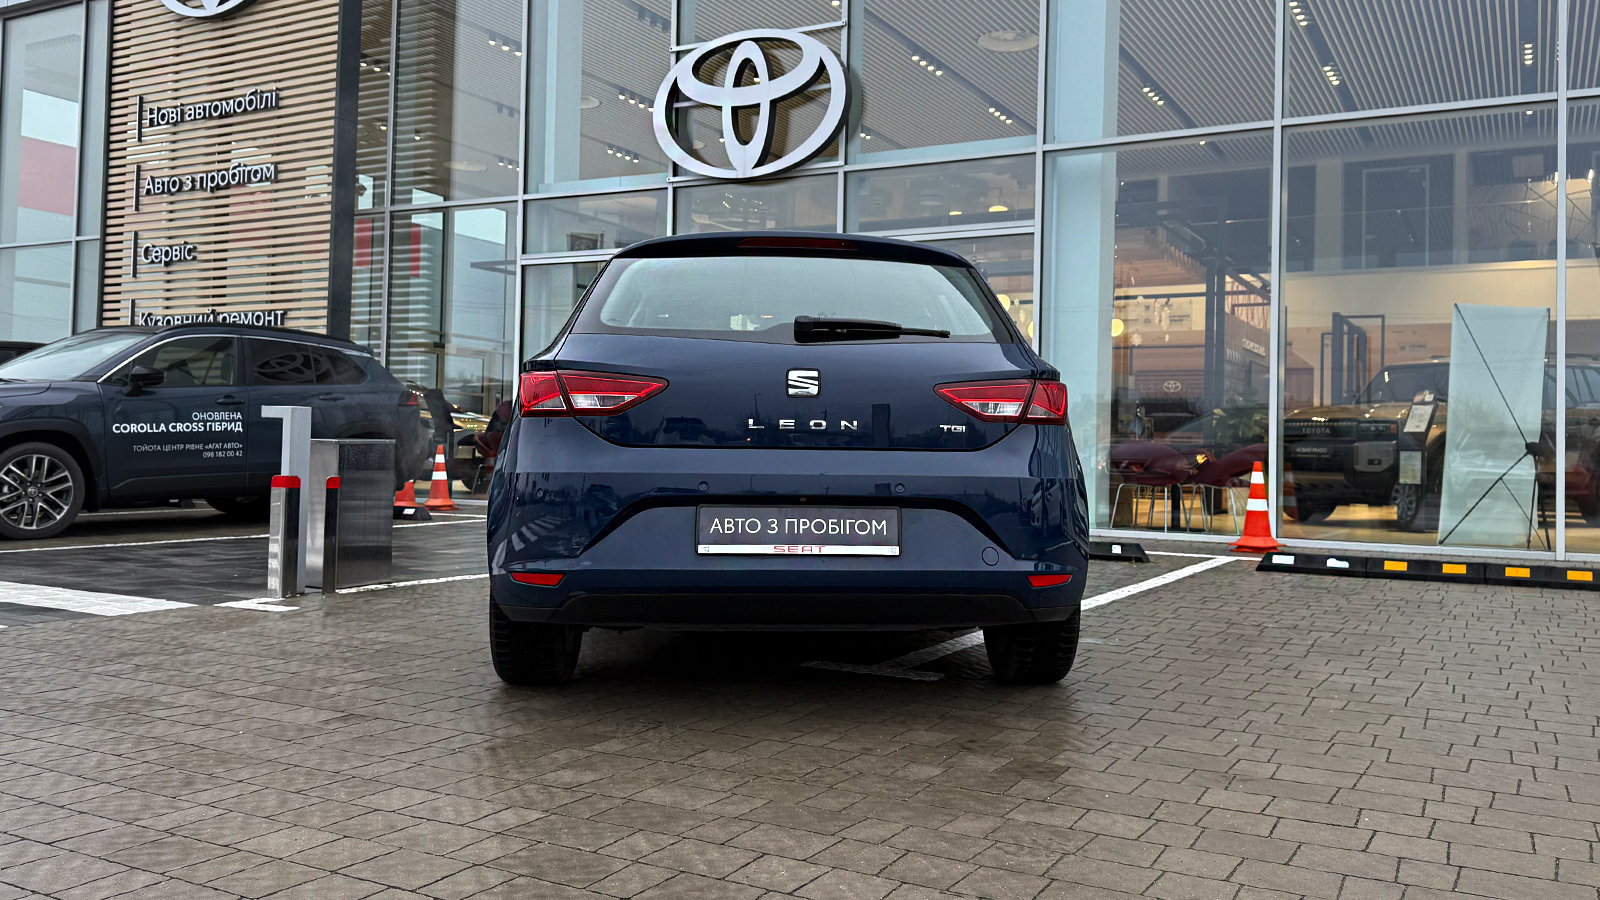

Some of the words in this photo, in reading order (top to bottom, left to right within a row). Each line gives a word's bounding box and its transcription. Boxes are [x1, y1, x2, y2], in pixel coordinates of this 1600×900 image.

[147, 102, 183, 126] Нові
[186, 86, 277, 120] автомобілі
[144, 175, 180, 194] Авто
[183, 174, 193, 190] з
[197, 162, 275, 193] пробігом
[141, 240, 194, 267] Сервіс
[191, 411, 243, 421] ОНОВЛЕНА
[112, 423, 167, 433] COROLLA
[168, 422, 204, 432] CROSS
[206, 421, 243, 433] ГІБРИД
[748, 418, 858, 430] LEON
[939, 424, 966, 433] TGI
[133, 443, 161, 452] ТОЙОТА
[162, 444, 184, 452] ЦЕНТР
[709, 517, 761, 534] АВТО
[767, 518, 779, 534] З
[785, 518, 887, 535] ПРОБІГОМ
[773, 545, 826, 553] SEAT
